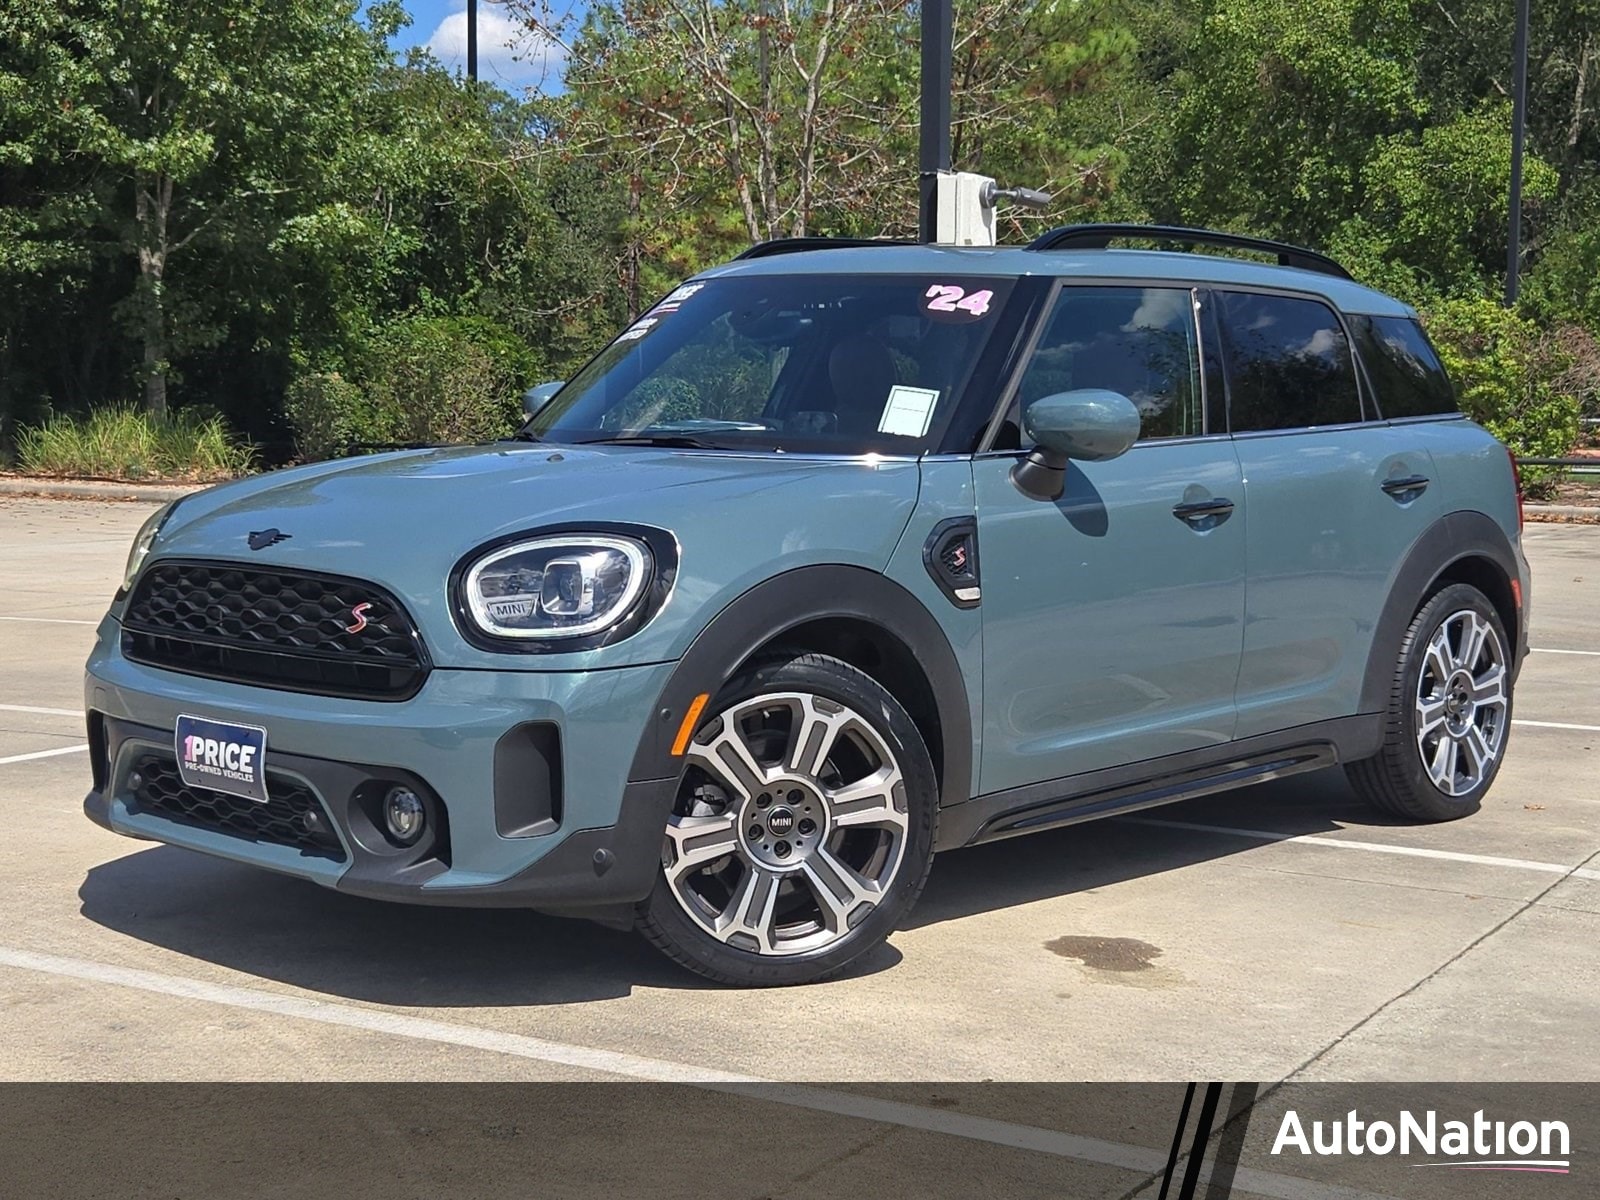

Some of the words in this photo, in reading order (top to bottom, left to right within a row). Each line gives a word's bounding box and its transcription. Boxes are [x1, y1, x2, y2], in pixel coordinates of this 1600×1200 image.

[345, 602, 373, 634] S
[496, 604, 526, 616] MINI
[184, 734, 257, 774] 1PRICE
[184, 761, 222, 776] PRE-OWNED
[222, 768, 255, 783] VEHICLES
[771, 817, 792, 827] MINI
